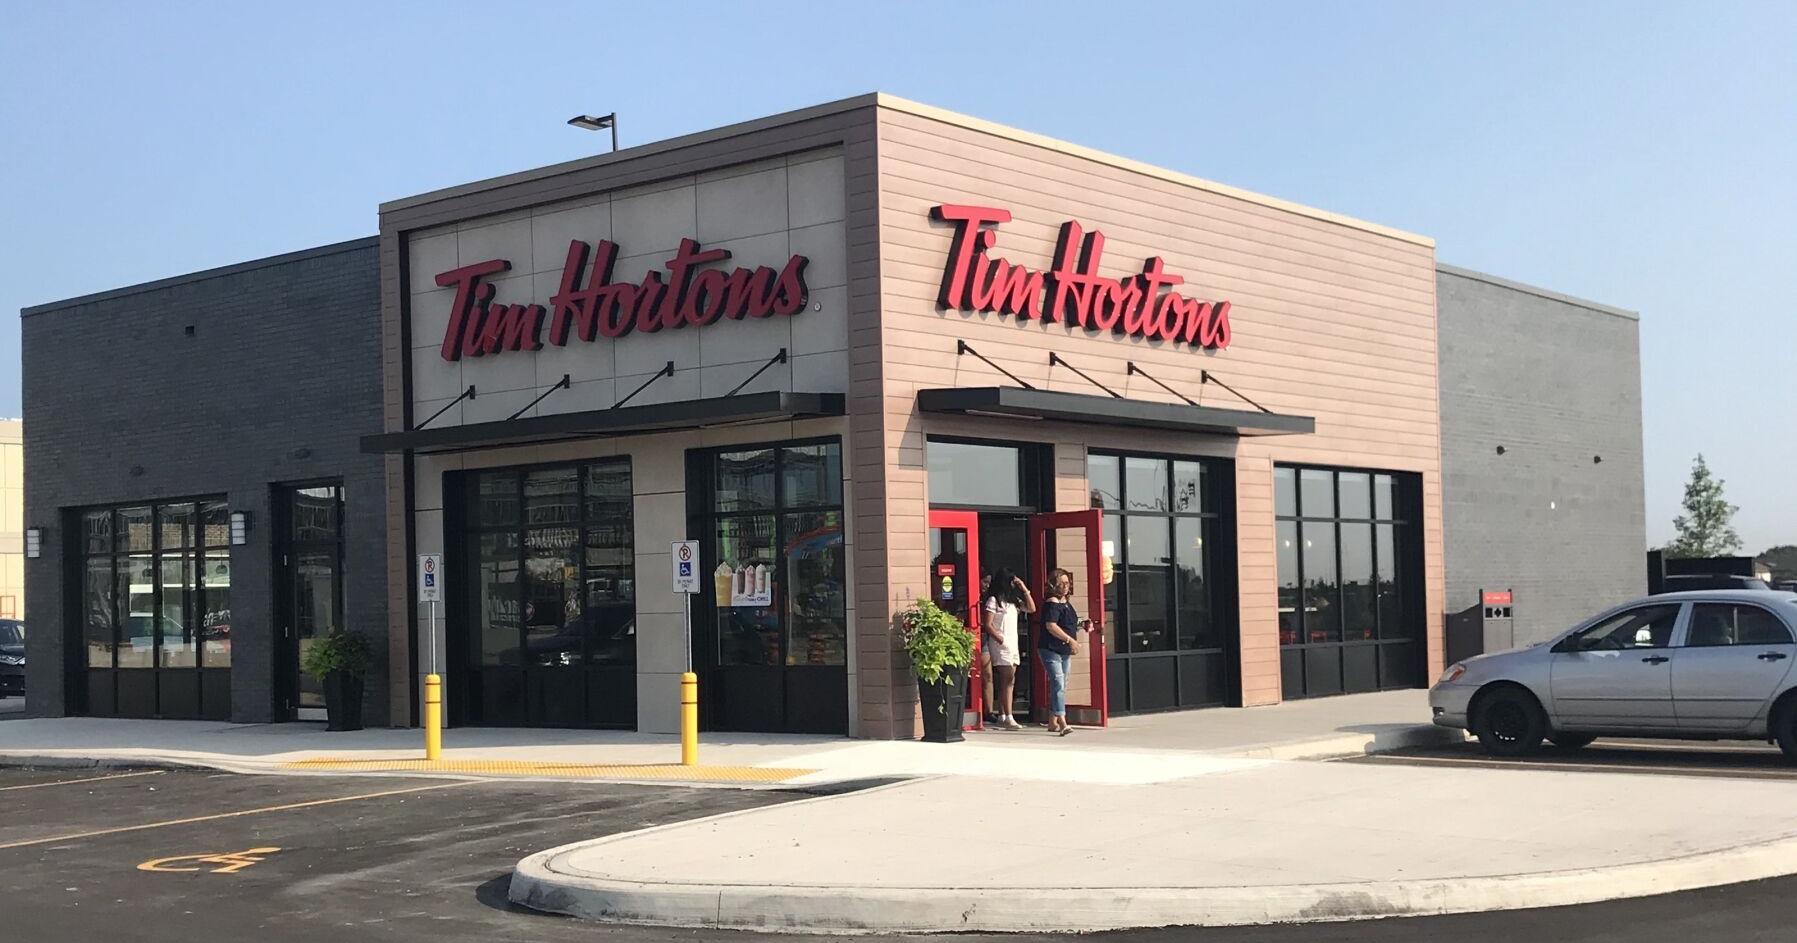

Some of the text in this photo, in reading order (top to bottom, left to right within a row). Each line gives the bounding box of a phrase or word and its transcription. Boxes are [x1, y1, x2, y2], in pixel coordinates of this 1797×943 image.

[434, 237, 810, 362] Tim Hortons
[928, 203, 1231, 350] Tim Hortons
